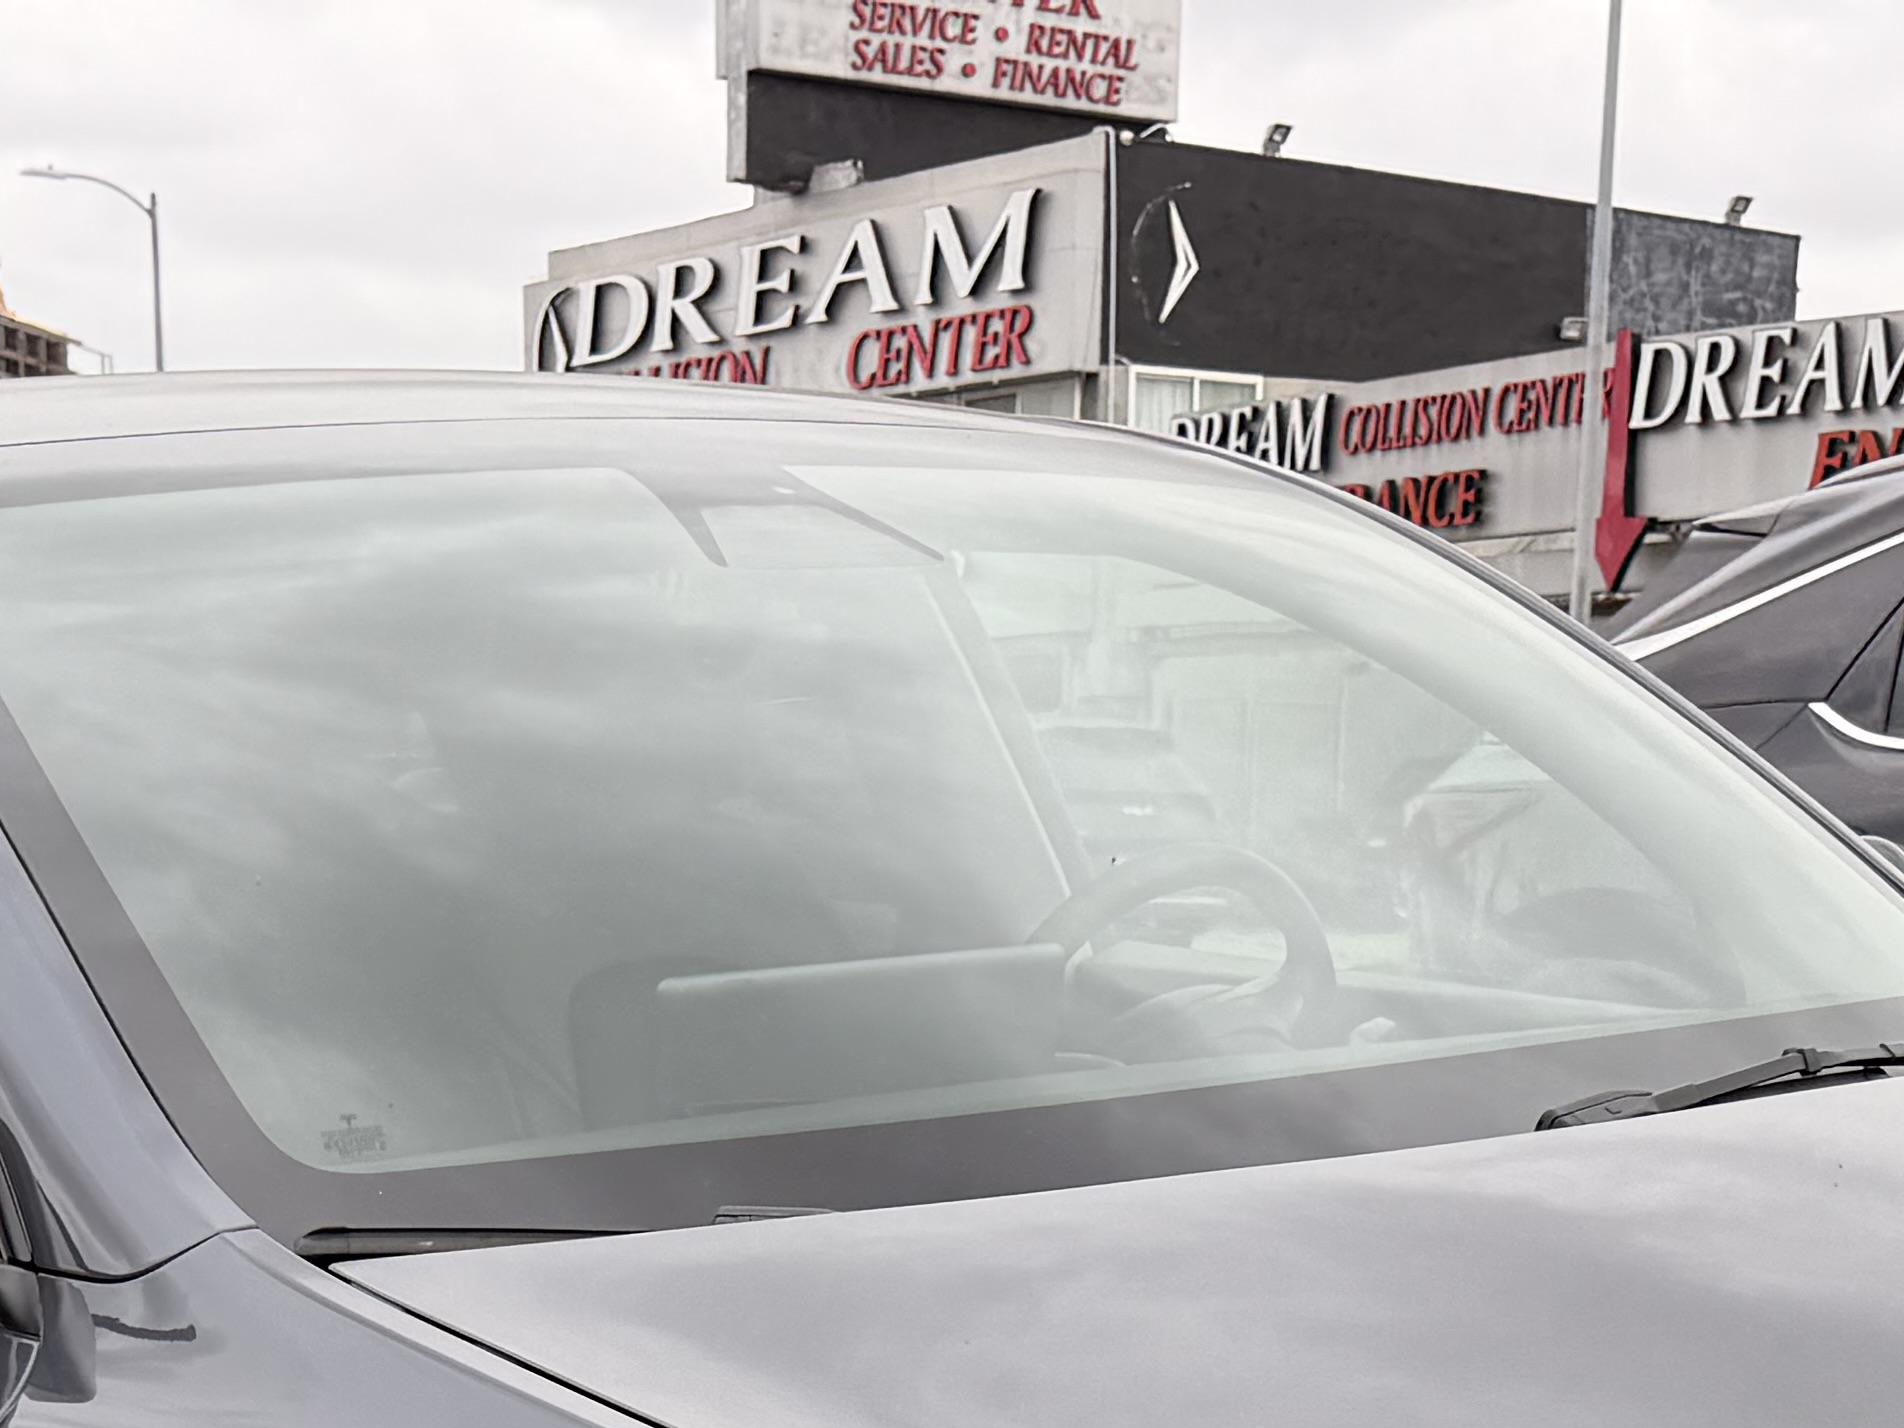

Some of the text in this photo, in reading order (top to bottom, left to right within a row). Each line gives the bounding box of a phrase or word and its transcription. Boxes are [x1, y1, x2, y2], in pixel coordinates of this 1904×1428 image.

[849, 0, 980, 45] SERVICE
[1025, 22, 1138, 71] RENTAL
[851, 38, 1126, 106] SALES FINANCE
[568, 187, 1044, 368] DREAM
[846, 304, 1033, 392] CENTER
[1339, 368, 1614, 455] COLLISION CENTR
